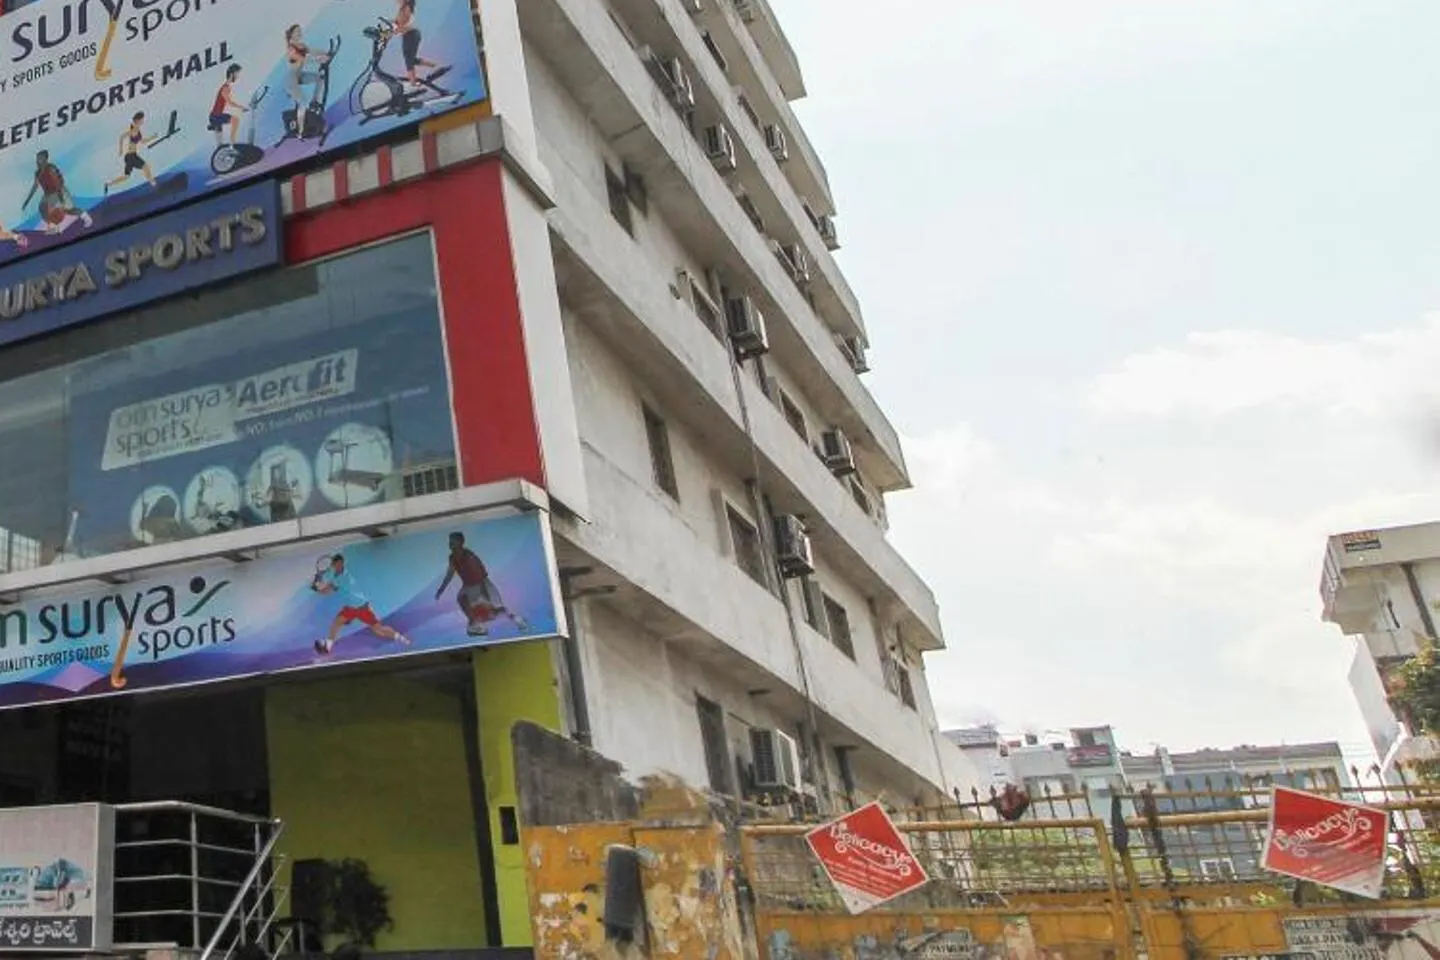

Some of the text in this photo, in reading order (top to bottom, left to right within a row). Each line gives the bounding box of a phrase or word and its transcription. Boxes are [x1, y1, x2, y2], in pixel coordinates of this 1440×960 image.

[12, 60, 54, 90] SPORTS
[59, 42, 98, 69] GOODS
[56, 71, 154, 128] SPORTS
[161, 41, 234, 86] MALL
[105, 207, 267, 287] SPORTS
[116, 419, 191, 457] sports
[36, 649, 76, 668] SPORTS
[76, 644, 109, 662] GOODS
[138, 617, 236, 659] sports
